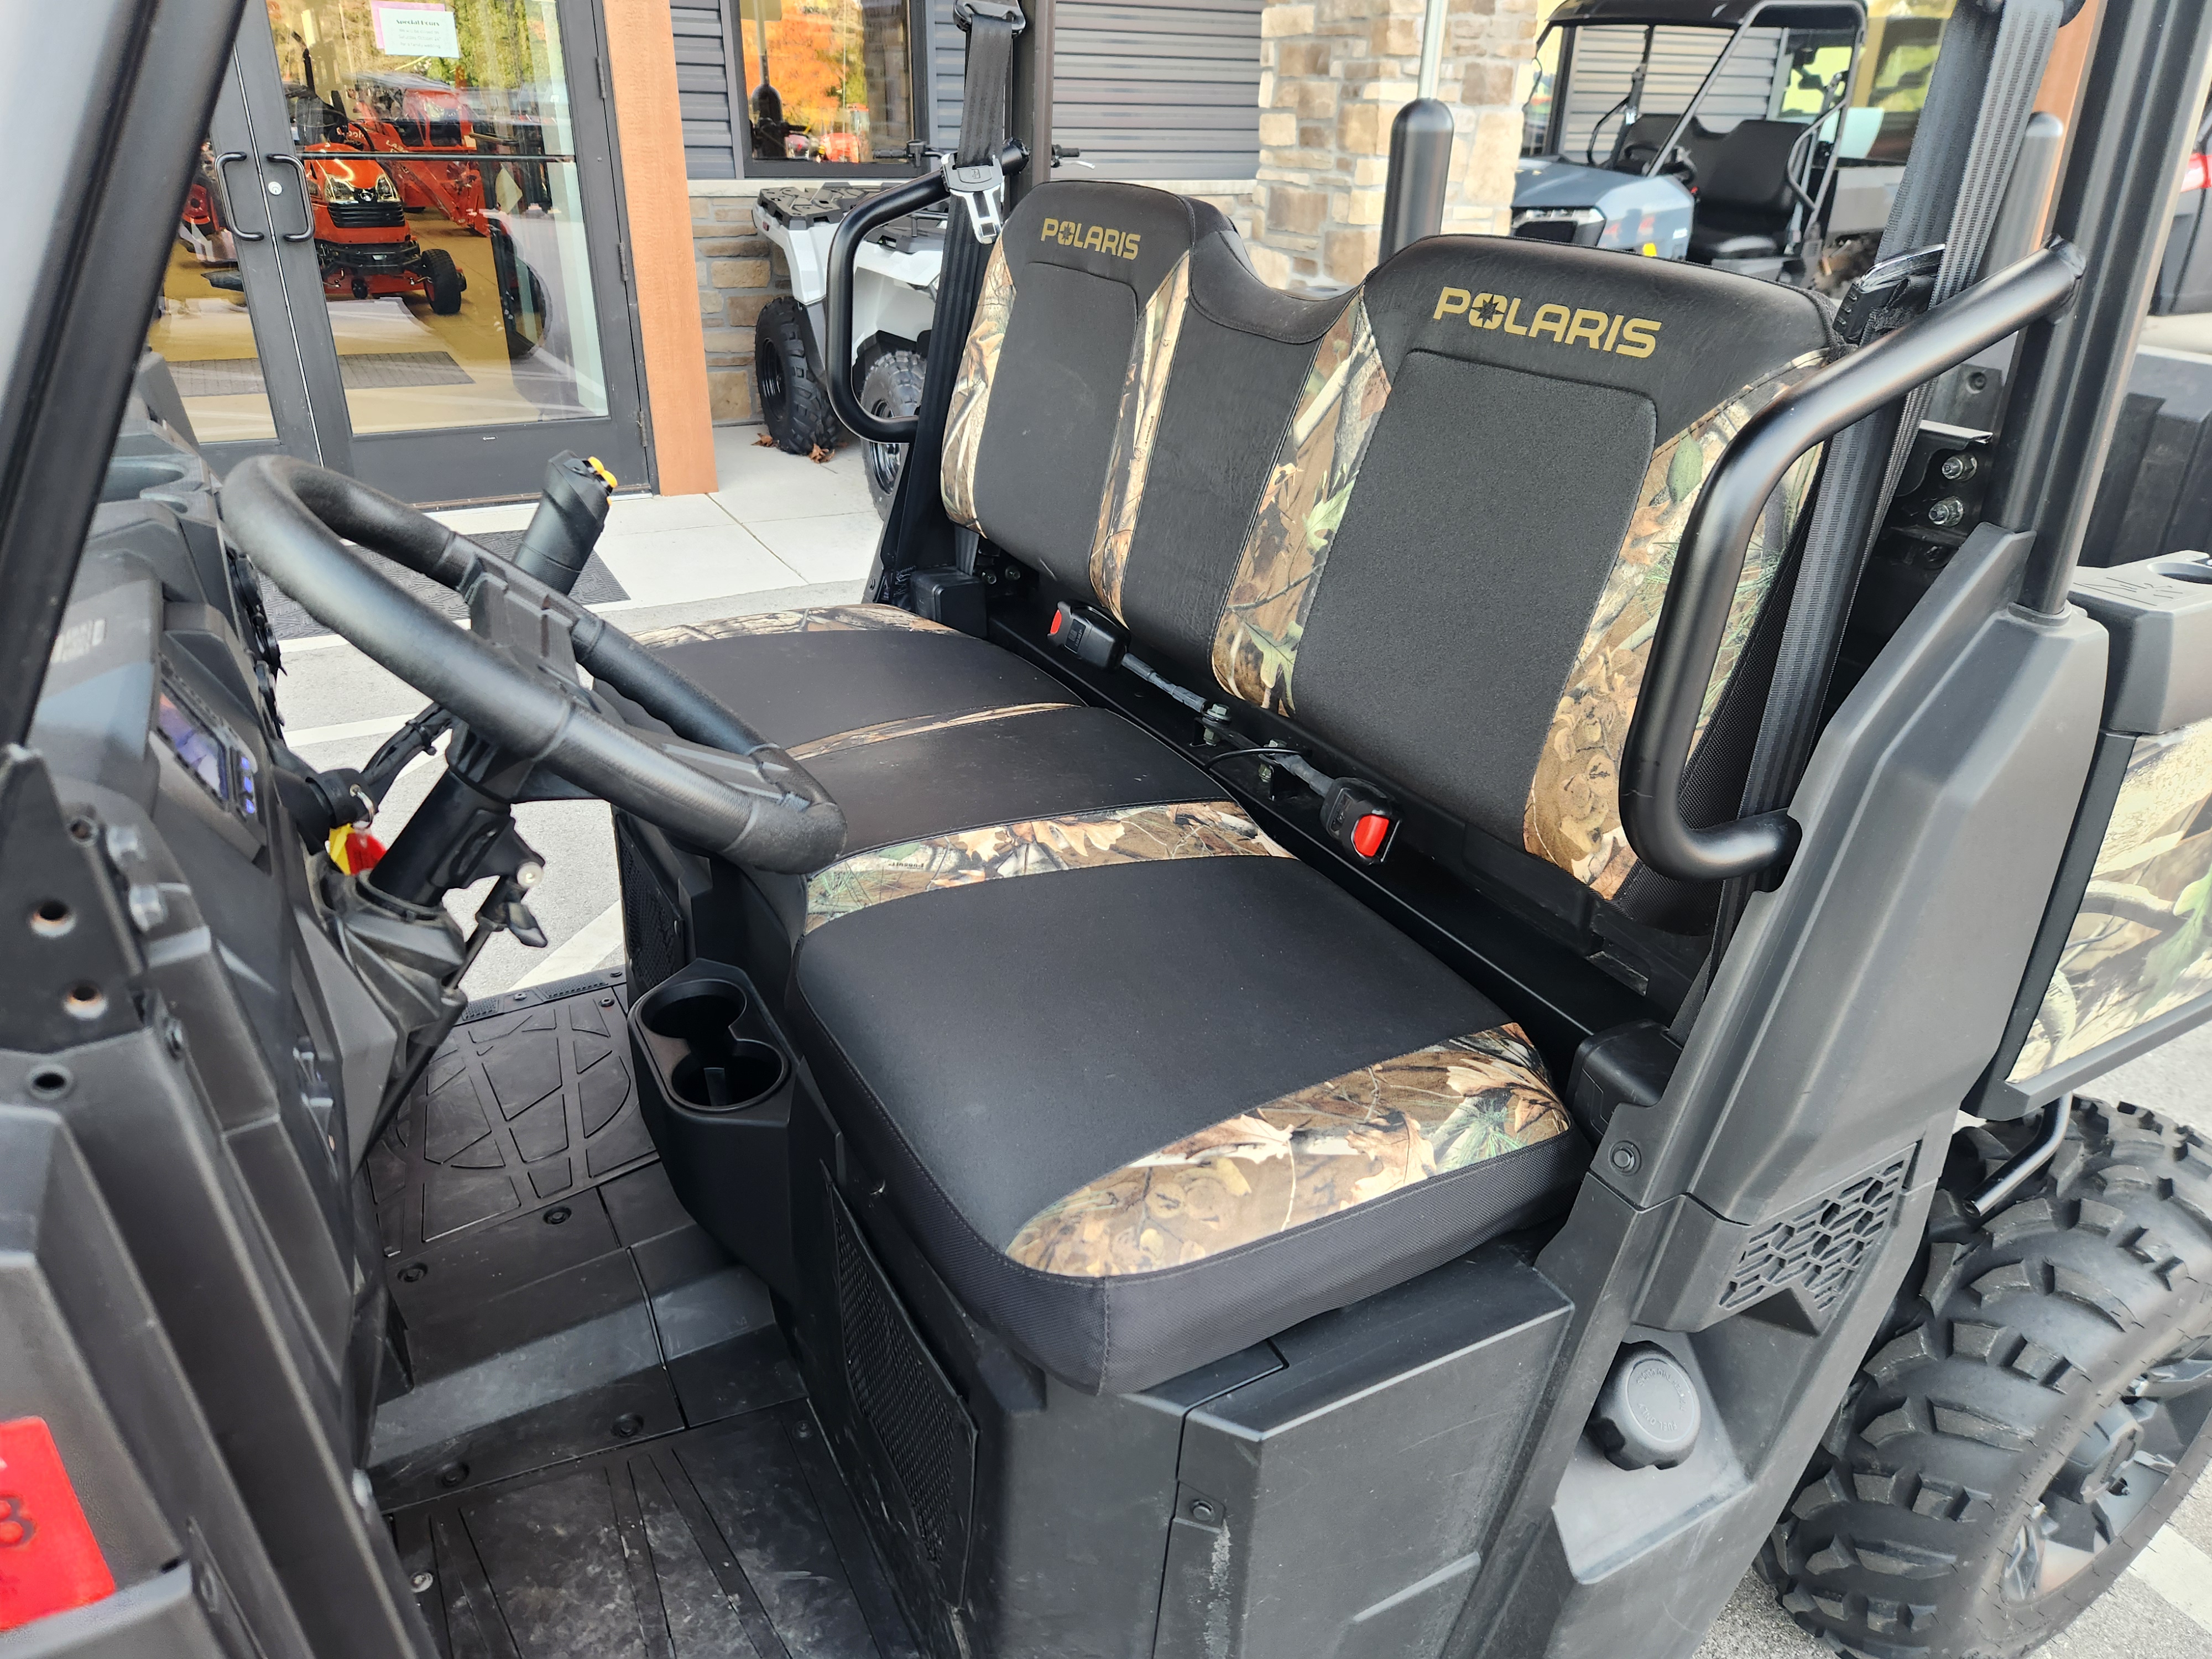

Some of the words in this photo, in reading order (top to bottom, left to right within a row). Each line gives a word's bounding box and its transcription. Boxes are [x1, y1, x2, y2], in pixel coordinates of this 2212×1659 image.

[1041, 218, 1141, 260] POLARIS
[1433, 286, 1662, 358] POLARIS
[1638, 1403, 1656, 1426] ONLY
[1659, 1420, 1678, 1431] FUEL
